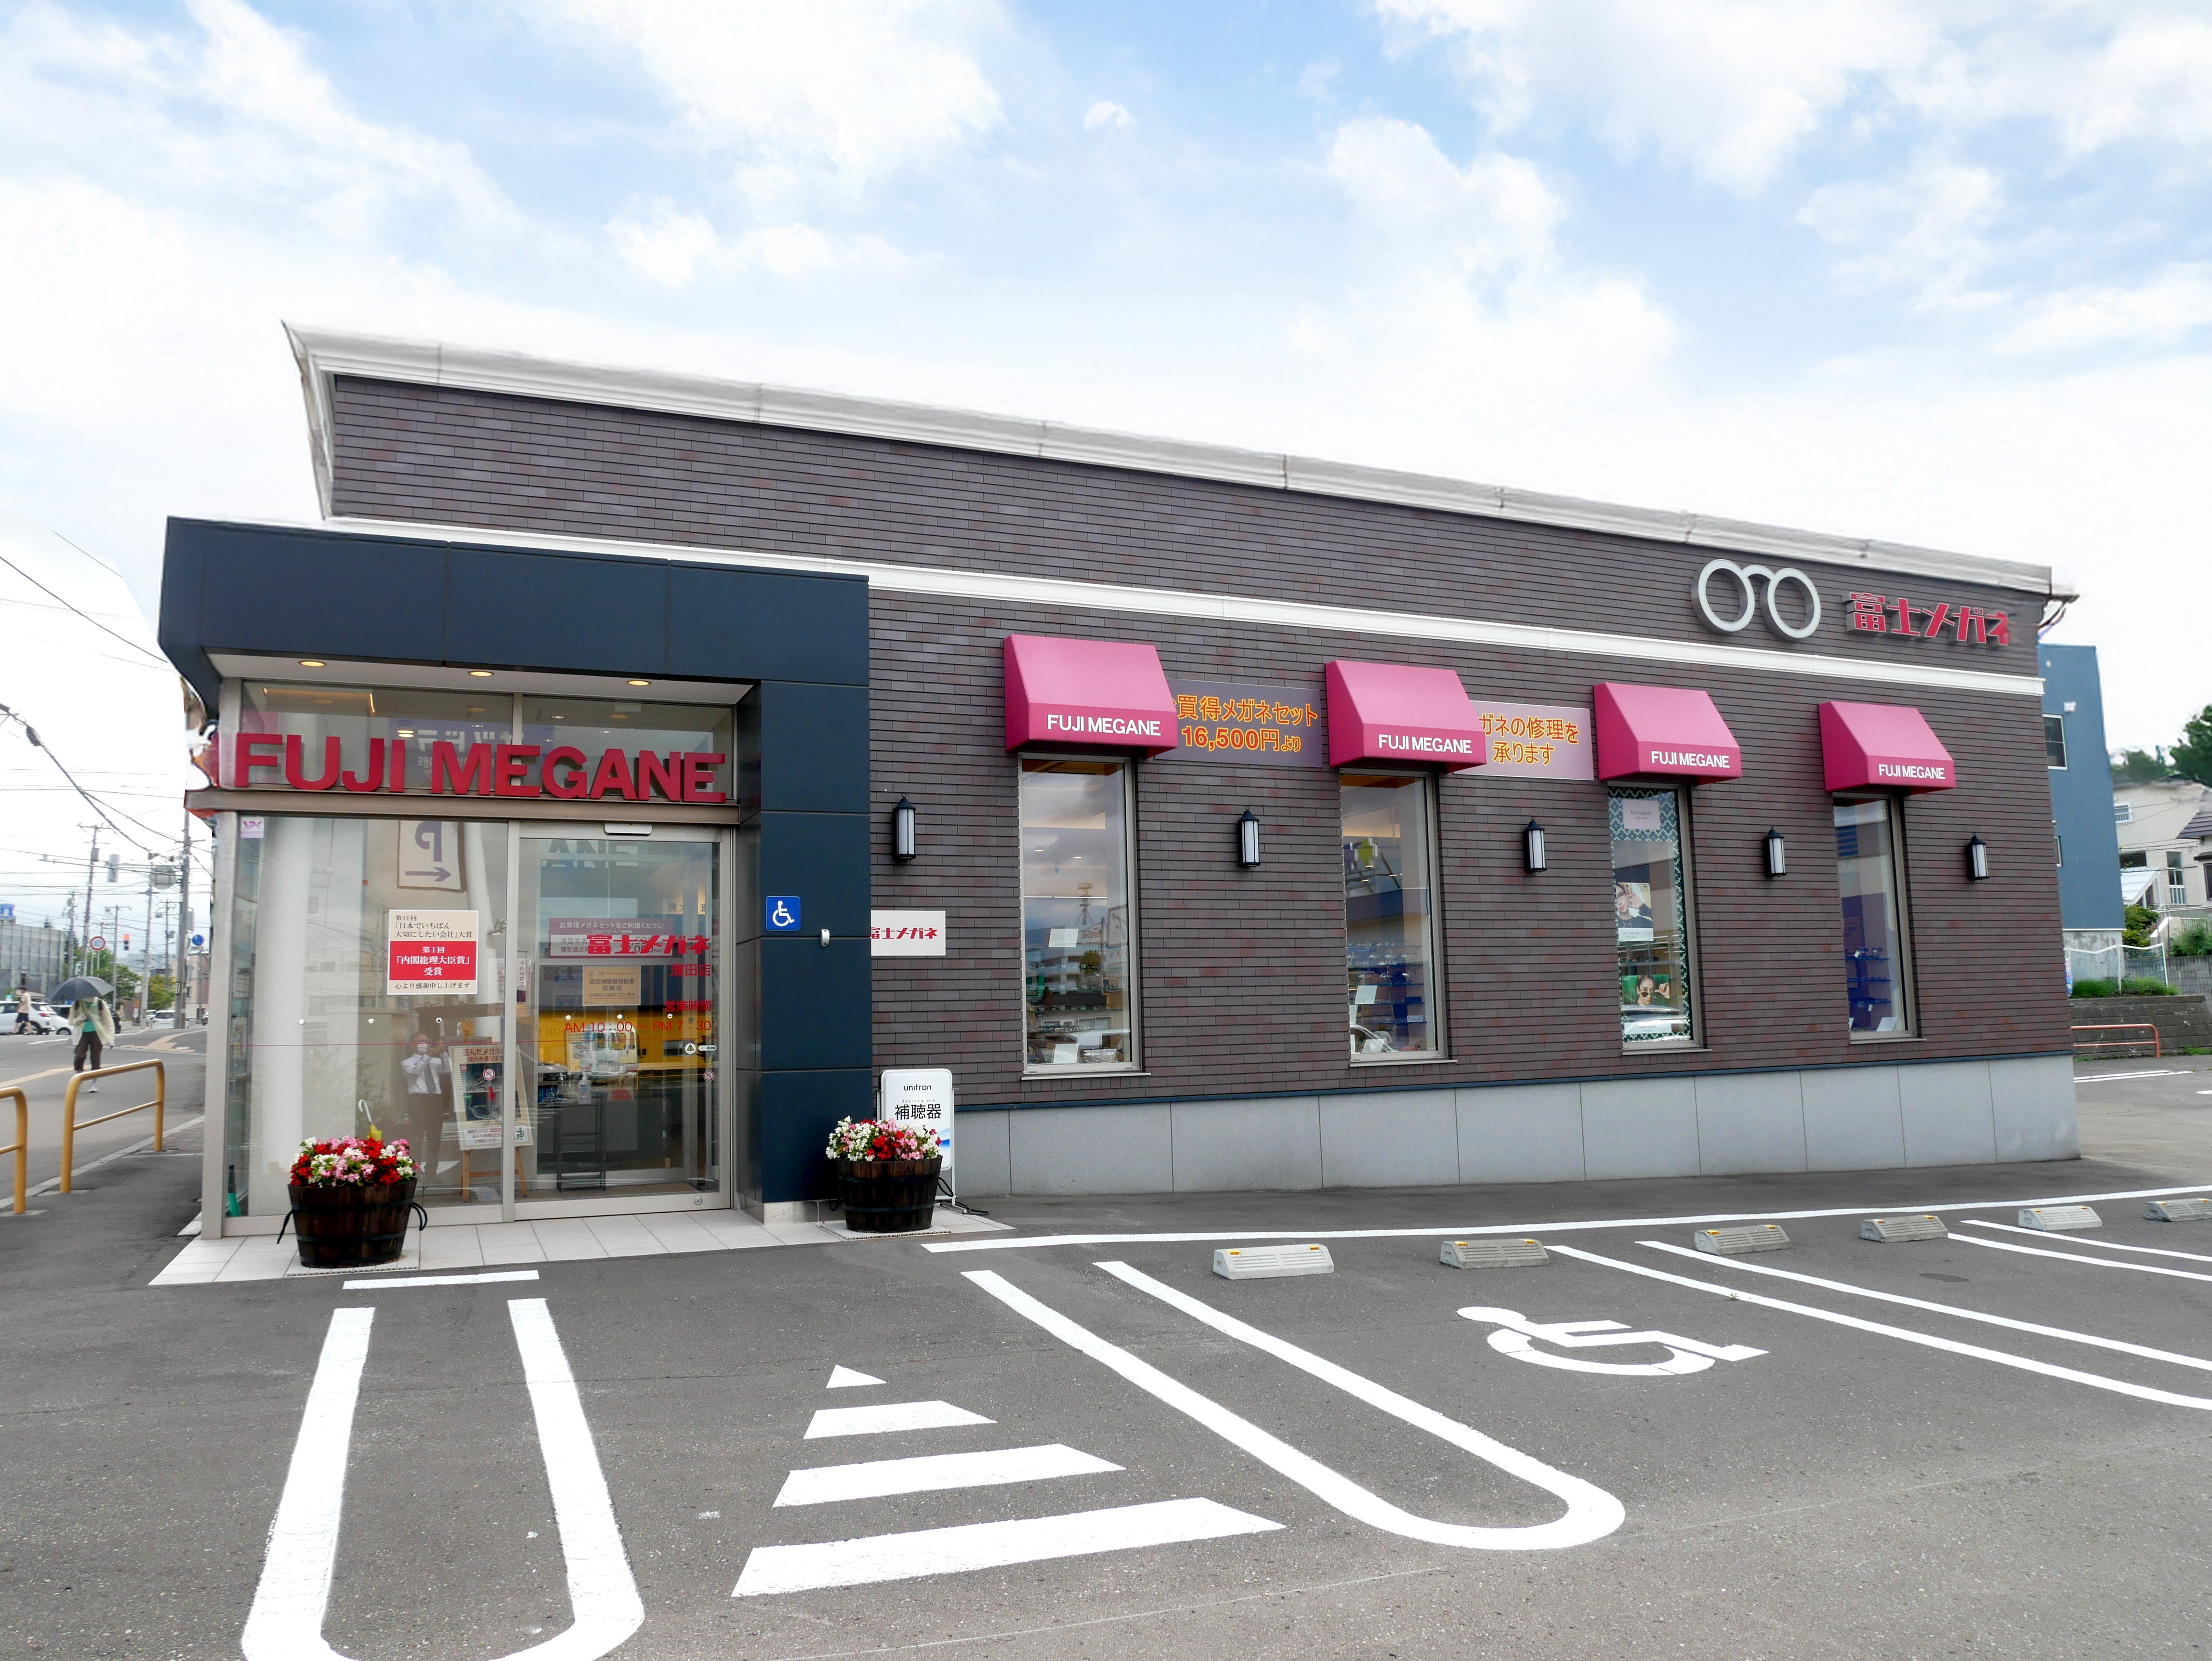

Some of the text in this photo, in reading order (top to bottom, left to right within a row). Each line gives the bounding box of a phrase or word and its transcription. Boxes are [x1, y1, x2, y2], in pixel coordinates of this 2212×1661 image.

[1849, 593, 2009, 646] 富士メガネ
[1172, 694, 1318, 727] 買得メガネセット
[1047, 714, 1161, 736] FUJI MEGANE
[1181, 725, 1301, 752] 16,500円より
[1379, 734, 1473, 754] FUJI MEGANE
[1492, 740, 1555, 766] 承ります
[1651, 751, 1730, 768] FUJI MEGANE
[235, 733, 725, 803] FUJI MEGANE
[1878, 764, 1946, 780] FUJI MEGANE
[871, 927, 938, 939] 富士メガネ
[587, 934, 711, 954] 富士メガネ
[423, 967, 443, 976] 受賞
[670, 963, 711, 976] 清田店
[665, 1000, 711, 1012] 営業時間
[564, 1022, 585, 1033] AM
[653, 1021, 672, 1031] PM
[895, 1104, 942, 1121] 補聴器
